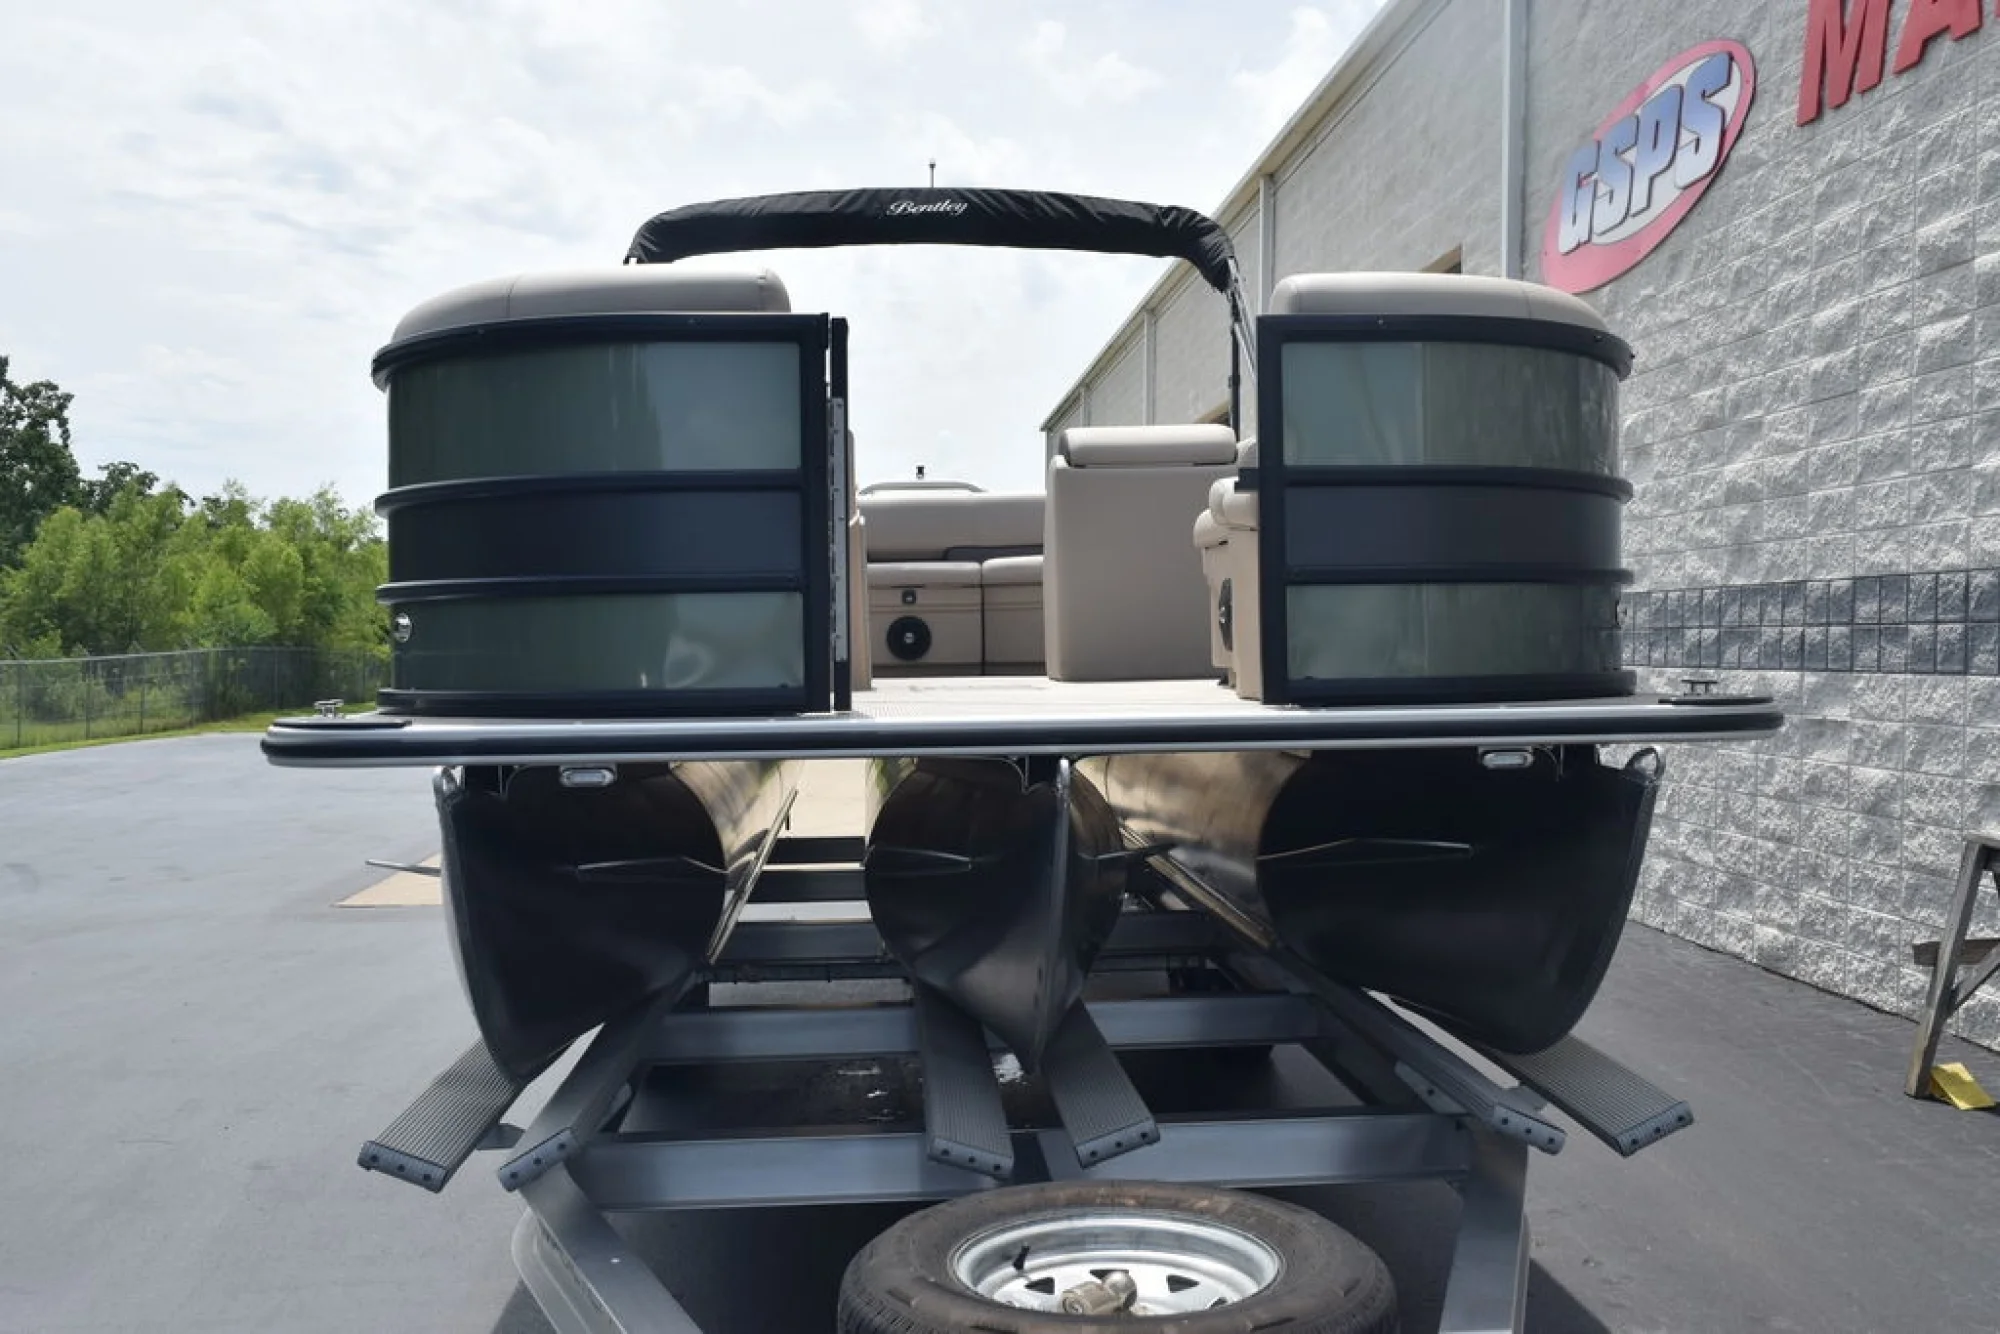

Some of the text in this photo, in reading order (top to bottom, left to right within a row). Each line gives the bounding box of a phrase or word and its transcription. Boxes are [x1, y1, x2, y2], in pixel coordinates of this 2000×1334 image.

[1796, 0, 2000, 127] MA
[886, 198, 968, 216] Bentley
[1557, 51, 1734, 255] GSPS
